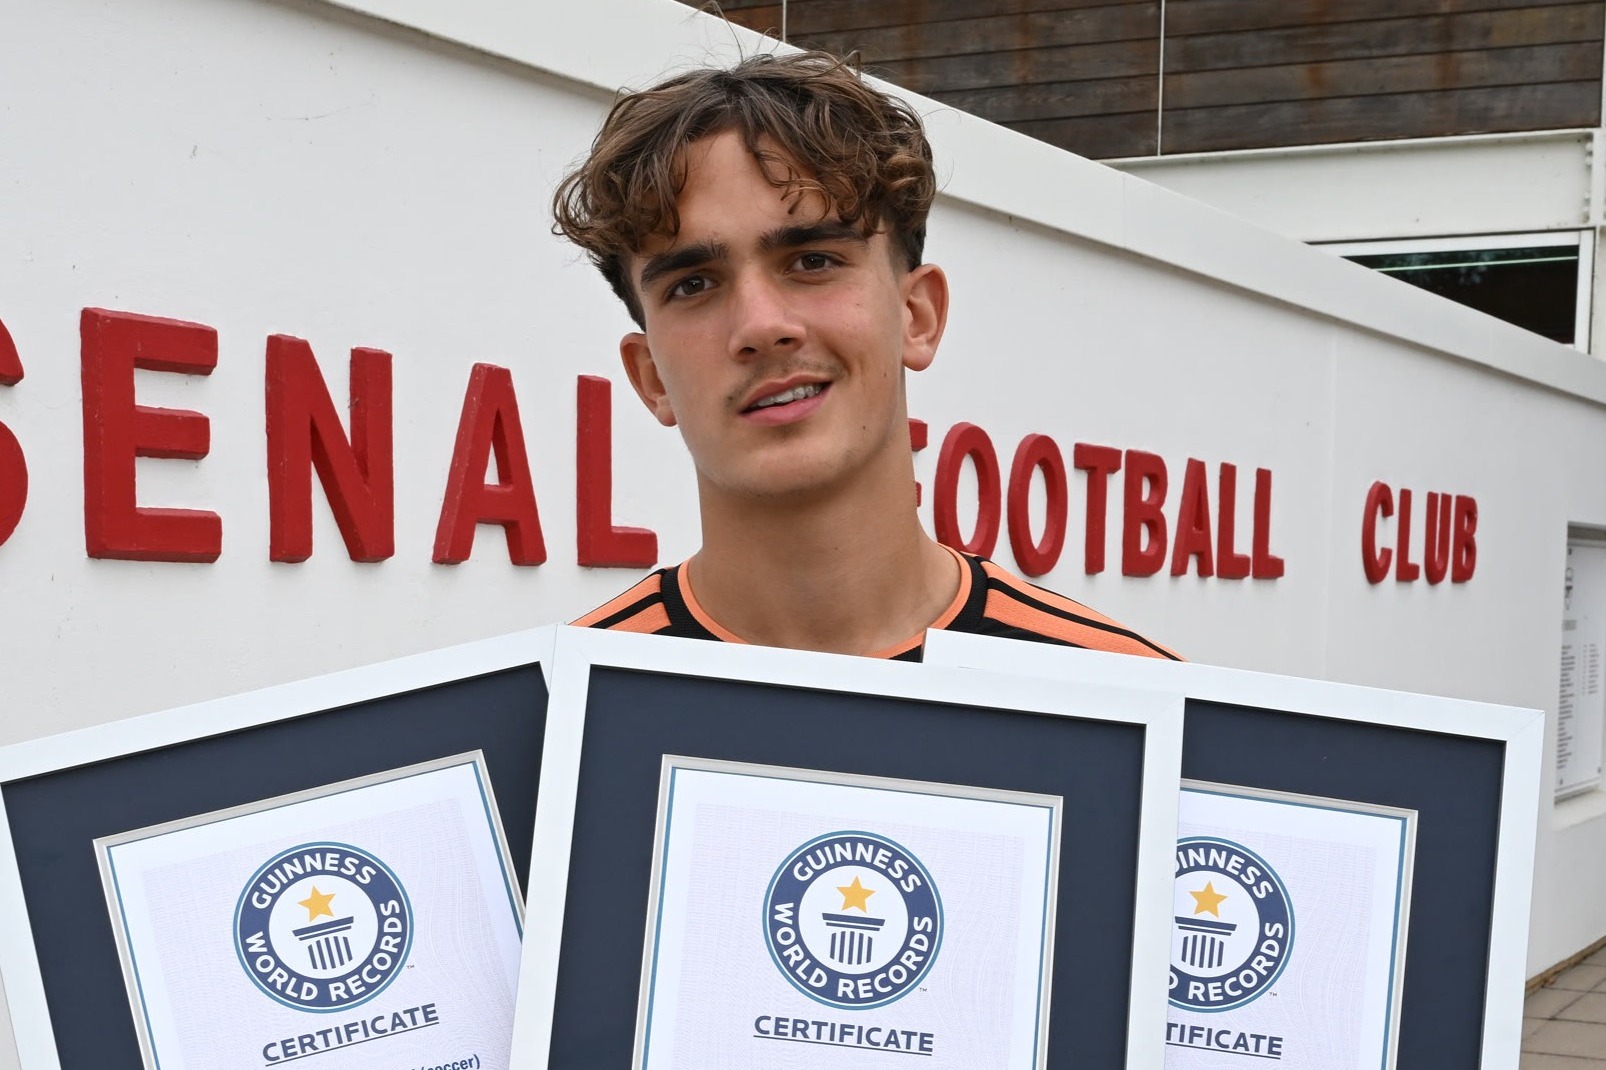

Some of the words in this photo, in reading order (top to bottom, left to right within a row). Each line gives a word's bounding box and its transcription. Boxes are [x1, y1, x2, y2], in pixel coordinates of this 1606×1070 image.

[0, 307, 657, 568] ENAL
[908, 418, 1285, 579] OOTBALL
[1362, 481, 1477, 585] CLUB
[252, 853, 377, 909] GUINNESS
[793, 842, 922, 893] GUINNESS
[1175, 848, 1274, 899] INNESS
[246, 931, 318, 1001] WORLD
[329, 899, 402, 1001] RECORDS
[774, 902, 828, 988] WORLD
[837, 916, 933, 999] RECORDS
[1188, 922, 1284, 1002] RECORDS
[262, 1003, 439, 1062] CERTIFICATE
[754, 1015, 934, 1053] CERTIFICATE
